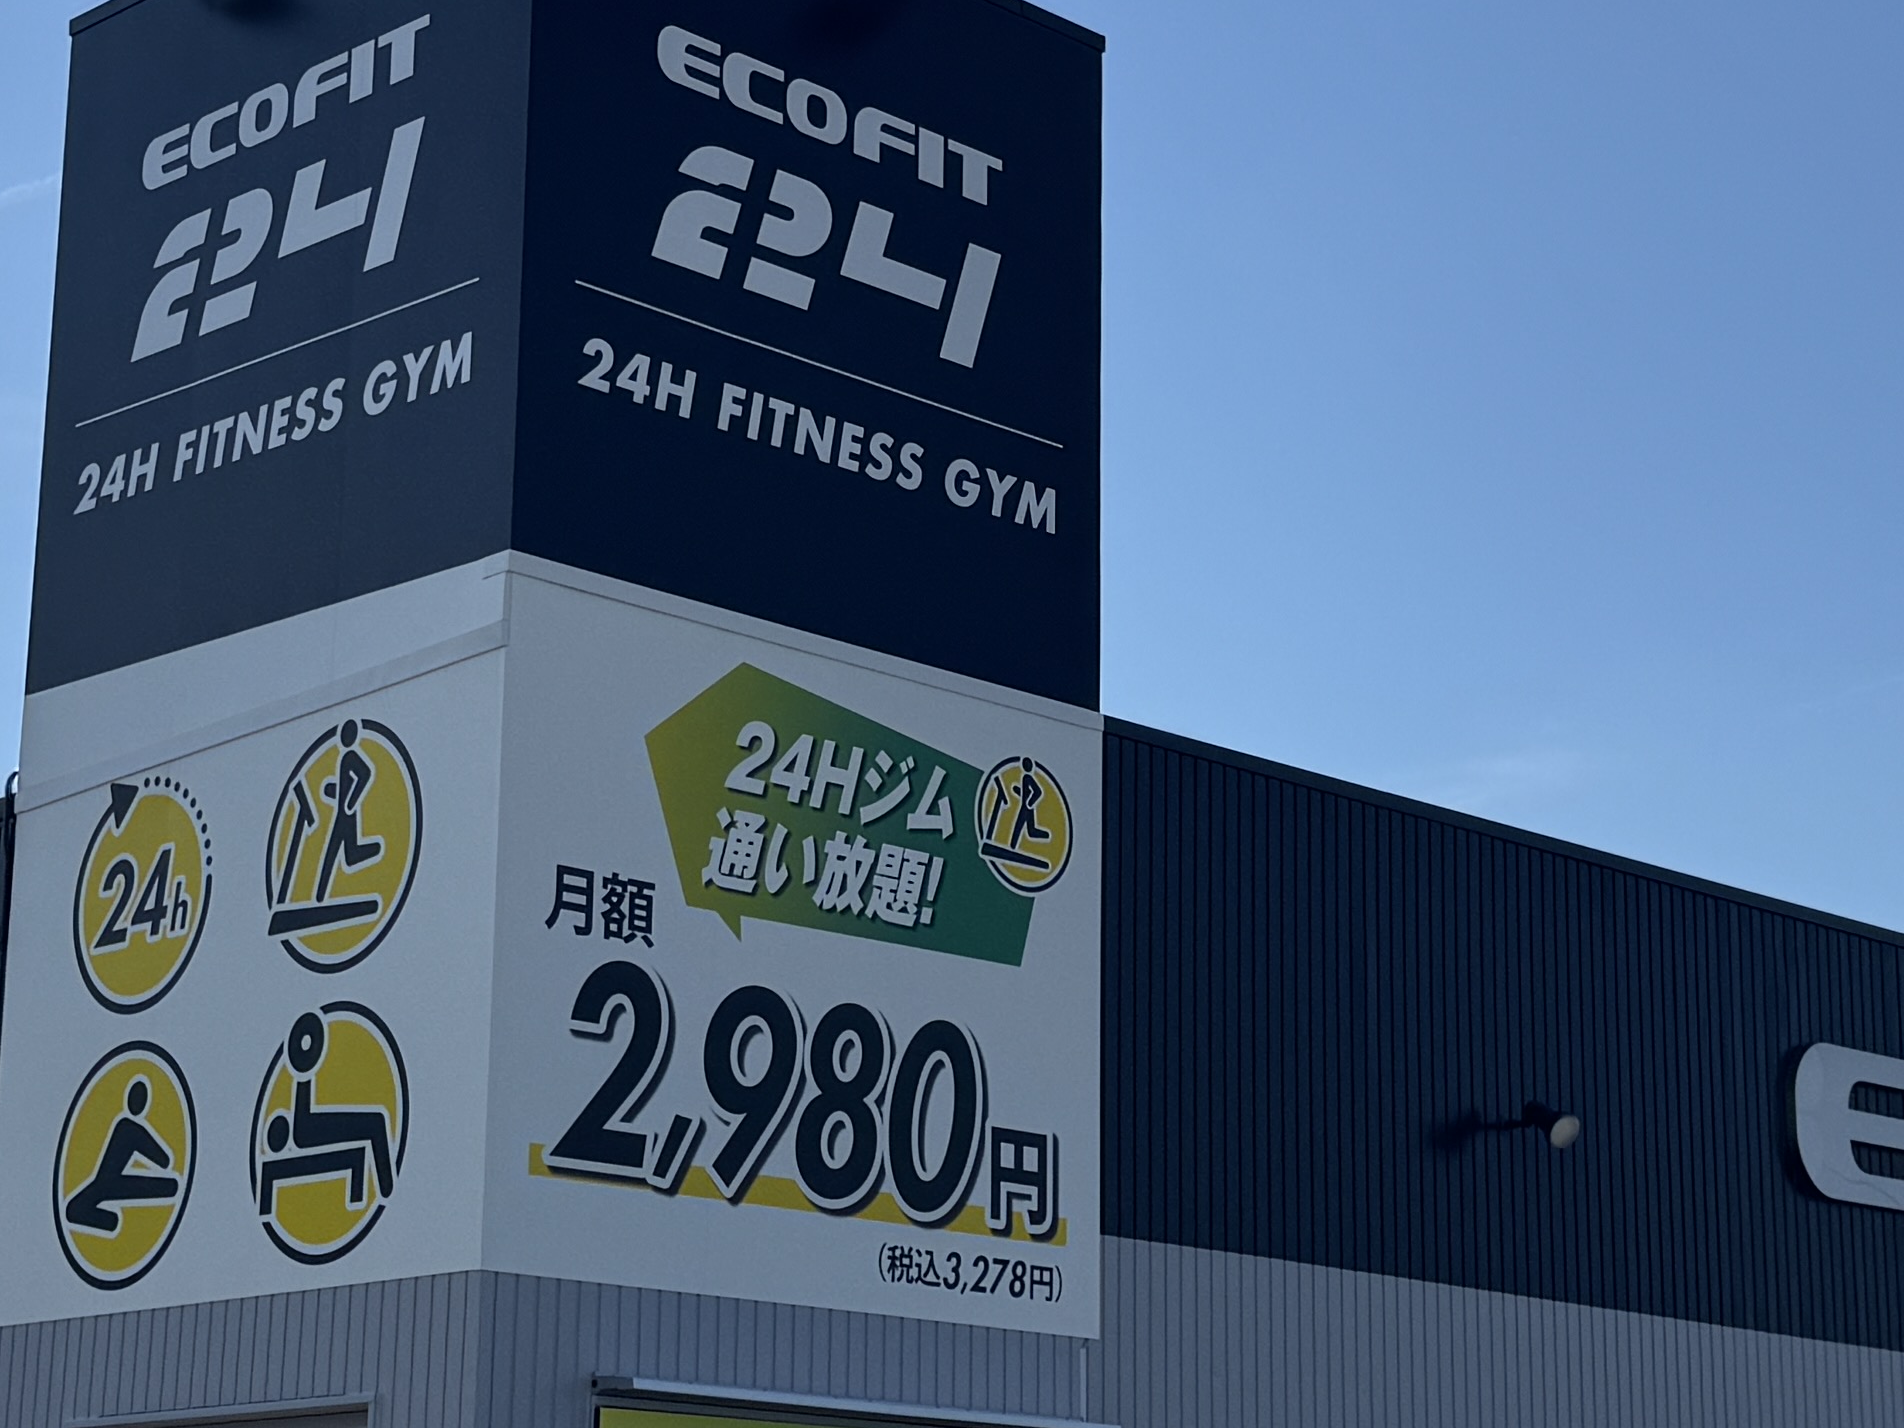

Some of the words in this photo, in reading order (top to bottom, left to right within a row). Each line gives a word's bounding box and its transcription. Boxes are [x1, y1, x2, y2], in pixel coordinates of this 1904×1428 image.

[142, 14, 430, 190] ECOFIT
[657, 25, 1003, 206] ECOFIT
[131, 116, 426, 363] 24
[651, 145, 1002, 369] 24
[74, 440, 157, 515] 24H
[173, 377, 346, 484] FITNESS
[363, 331, 474, 417] GYM
[578, 337, 696, 419] 24H
[717, 386, 924, 491] FITNESS
[944, 459, 1058, 535] GYM
[701, 806, 944, 927] 通い放題!
[724, 721, 954, 840] 24Hジム
[94, 847, 188, 950] 24h
[545, 865, 655, 948] 月額
[549, 961, 1058, 1236] 2,980円
